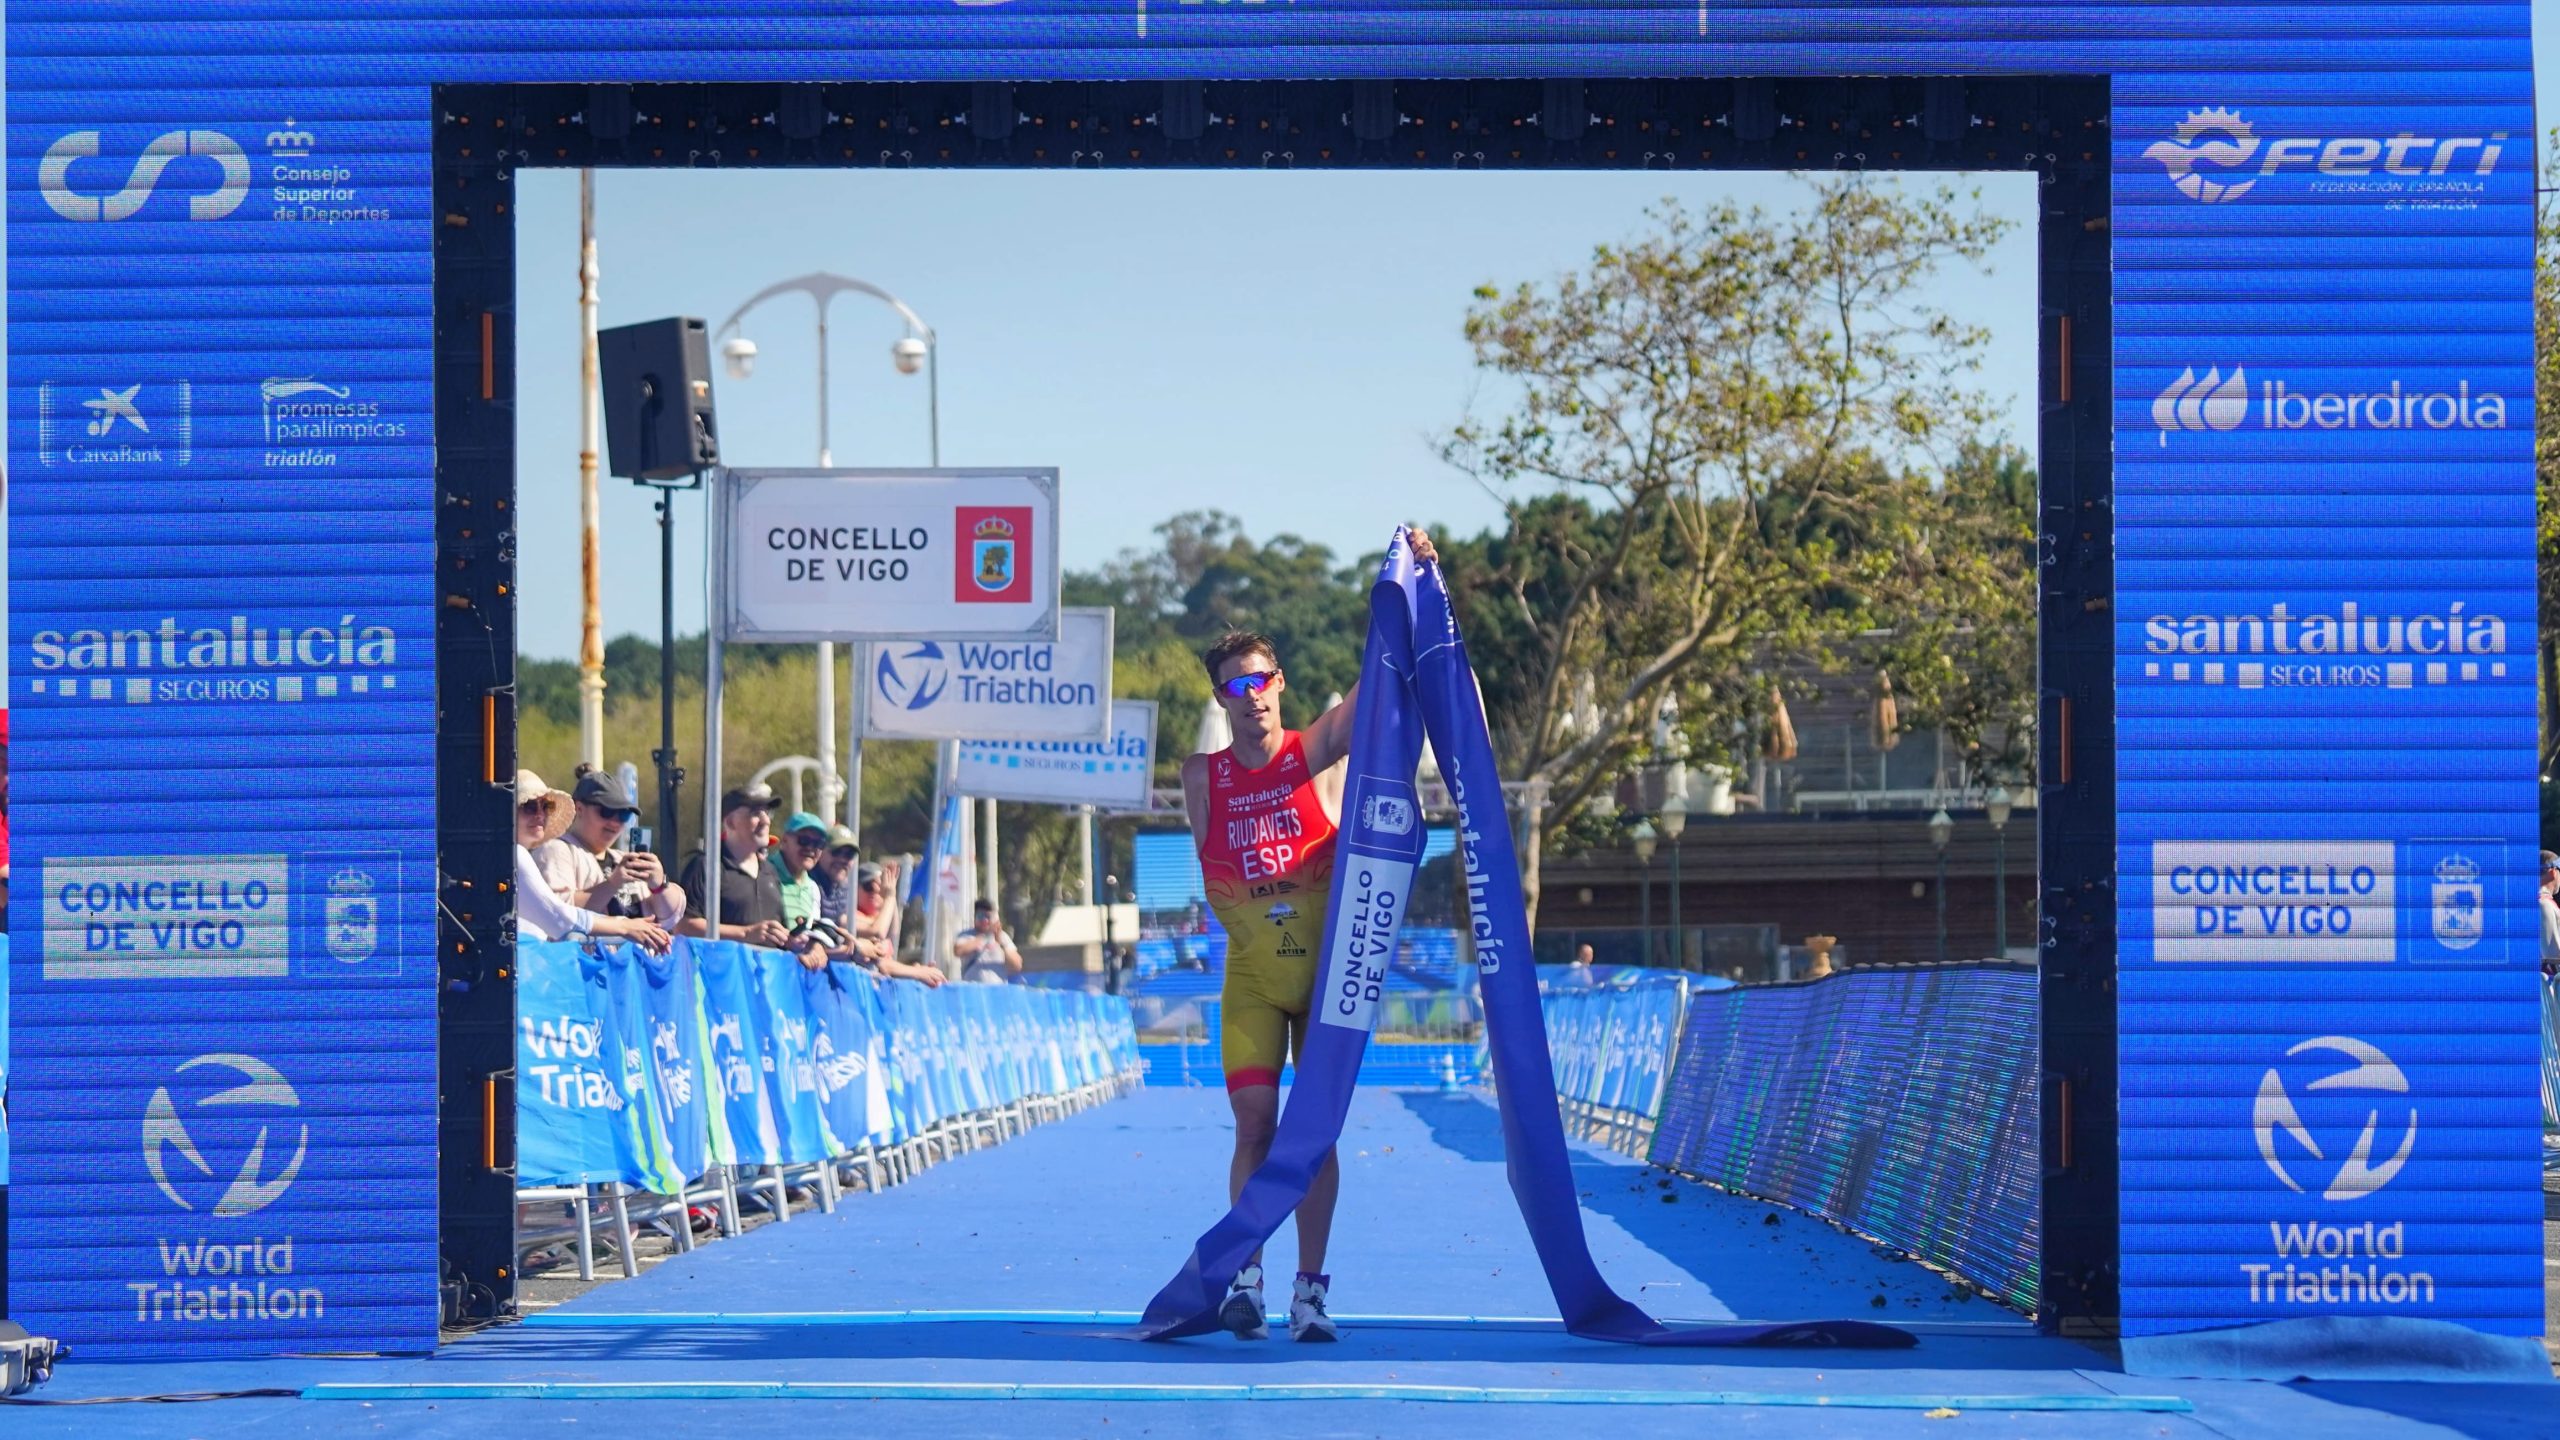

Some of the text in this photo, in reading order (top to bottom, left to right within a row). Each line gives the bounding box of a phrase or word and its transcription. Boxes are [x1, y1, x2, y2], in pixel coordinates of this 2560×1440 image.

[272, 165, 351, 184] Consejo
[273, 186, 357, 205] Superior
[273, 206, 390, 225] de Deportes
[276, 401, 379, 421] promesas
[2263, 379, 2507, 429] Iberdrola
[277, 418, 406, 443] paralímpicas
[66, 444, 163, 464] CaixaBank
[264, 448, 337, 467] triatlón
[768, 527, 929, 551] CONCELLO
[787, 558, 909, 582] DE VIGO
[31, 614, 397, 670] santalucía
[2145, 601, 2507, 654] santalucía
[958, 642, 1052, 671] World
[158, 678, 270, 702] SEGUROS
[957, 675, 1096, 706] Triathlon
[2270, 664, 2381, 687] SEGUROS
[1228, 807, 1303, 851] RIUDAVETS
[1242, 844, 1294, 881] ESP
[2170, 865, 2376, 895] CONCELLO
[59, 880, 269, 913] CONCELLO
[2195, 904, 2353, 935] DE VIGO
[86, 919, 245, 952] DE VIGO
[1339, 870, 1373, 1016] CONCELLO
[1364, 890, 1396, 1003] DE VIGO
[1276, 948, 1307, 956] ARTIEM
[2270, 1221, 2404, 1259] World
[158, 1236, 293, 1276] World
[2240, 1264, 2435, 1303] Triathlon
[126, 1282, 324, 1322] Triathlon
